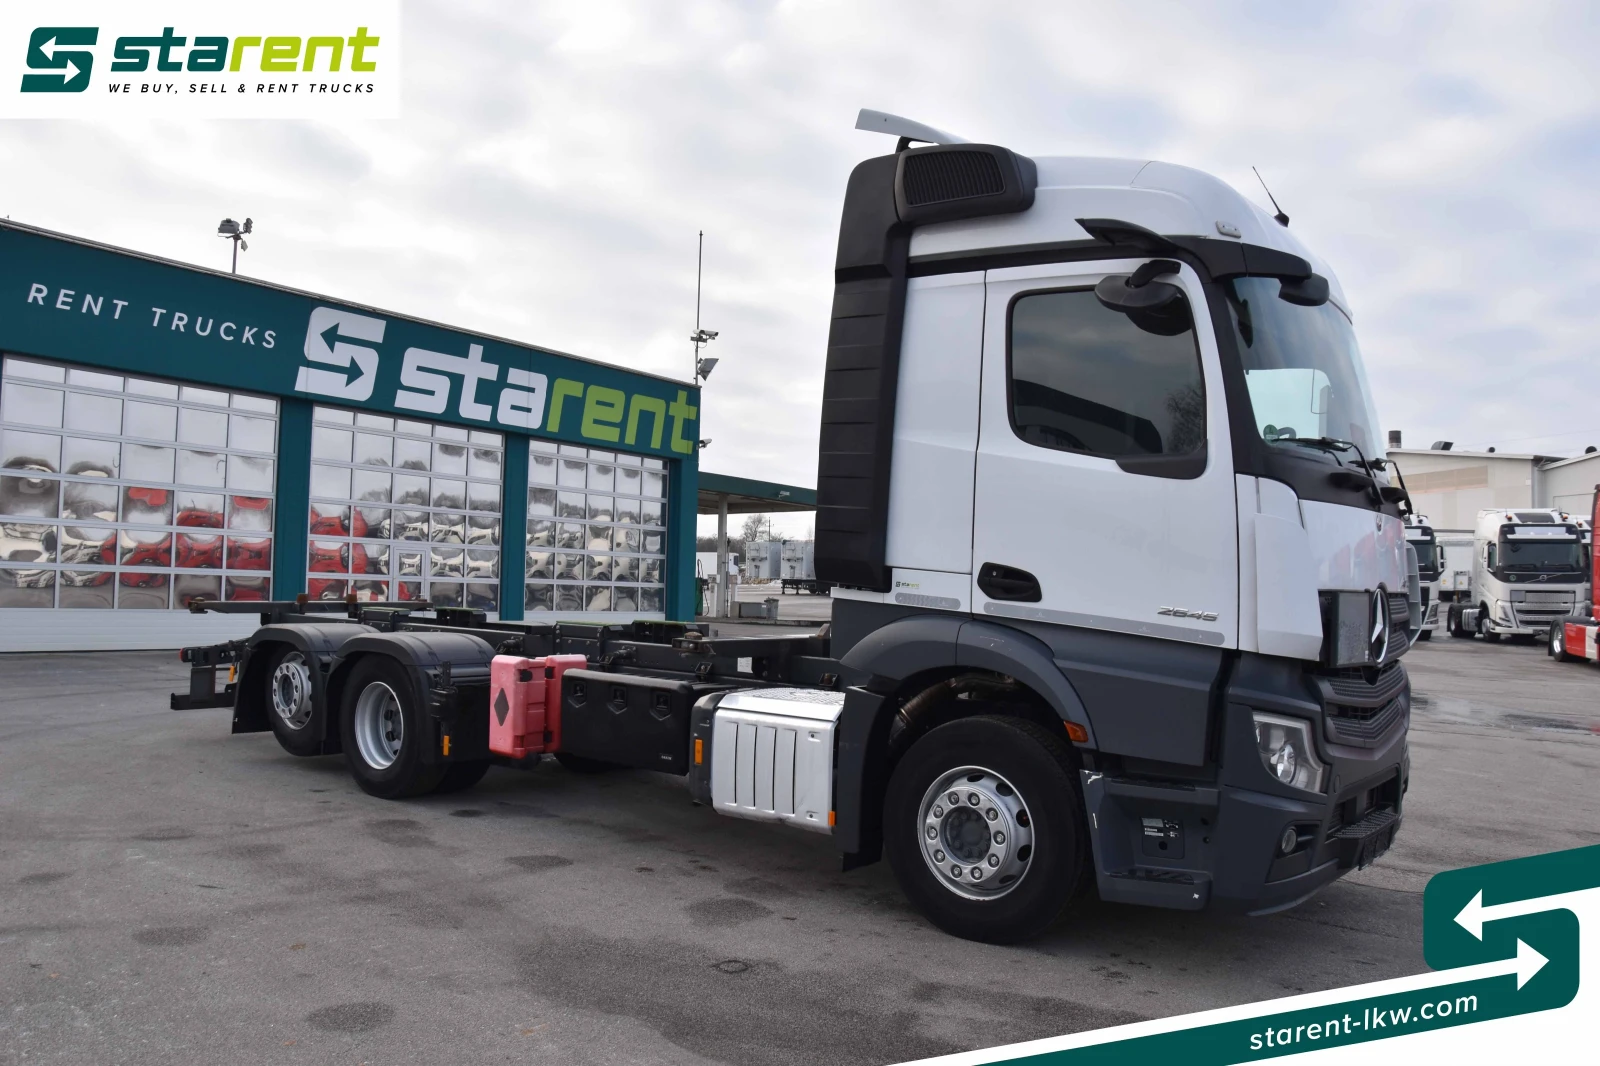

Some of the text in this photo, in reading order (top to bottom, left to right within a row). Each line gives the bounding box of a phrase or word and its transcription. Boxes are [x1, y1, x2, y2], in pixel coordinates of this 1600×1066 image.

[27, 282, 277, 349] RENT TRUCKS
[394, 343, 698, 454] starent
[1157, 605, 1219, 622] 2645
